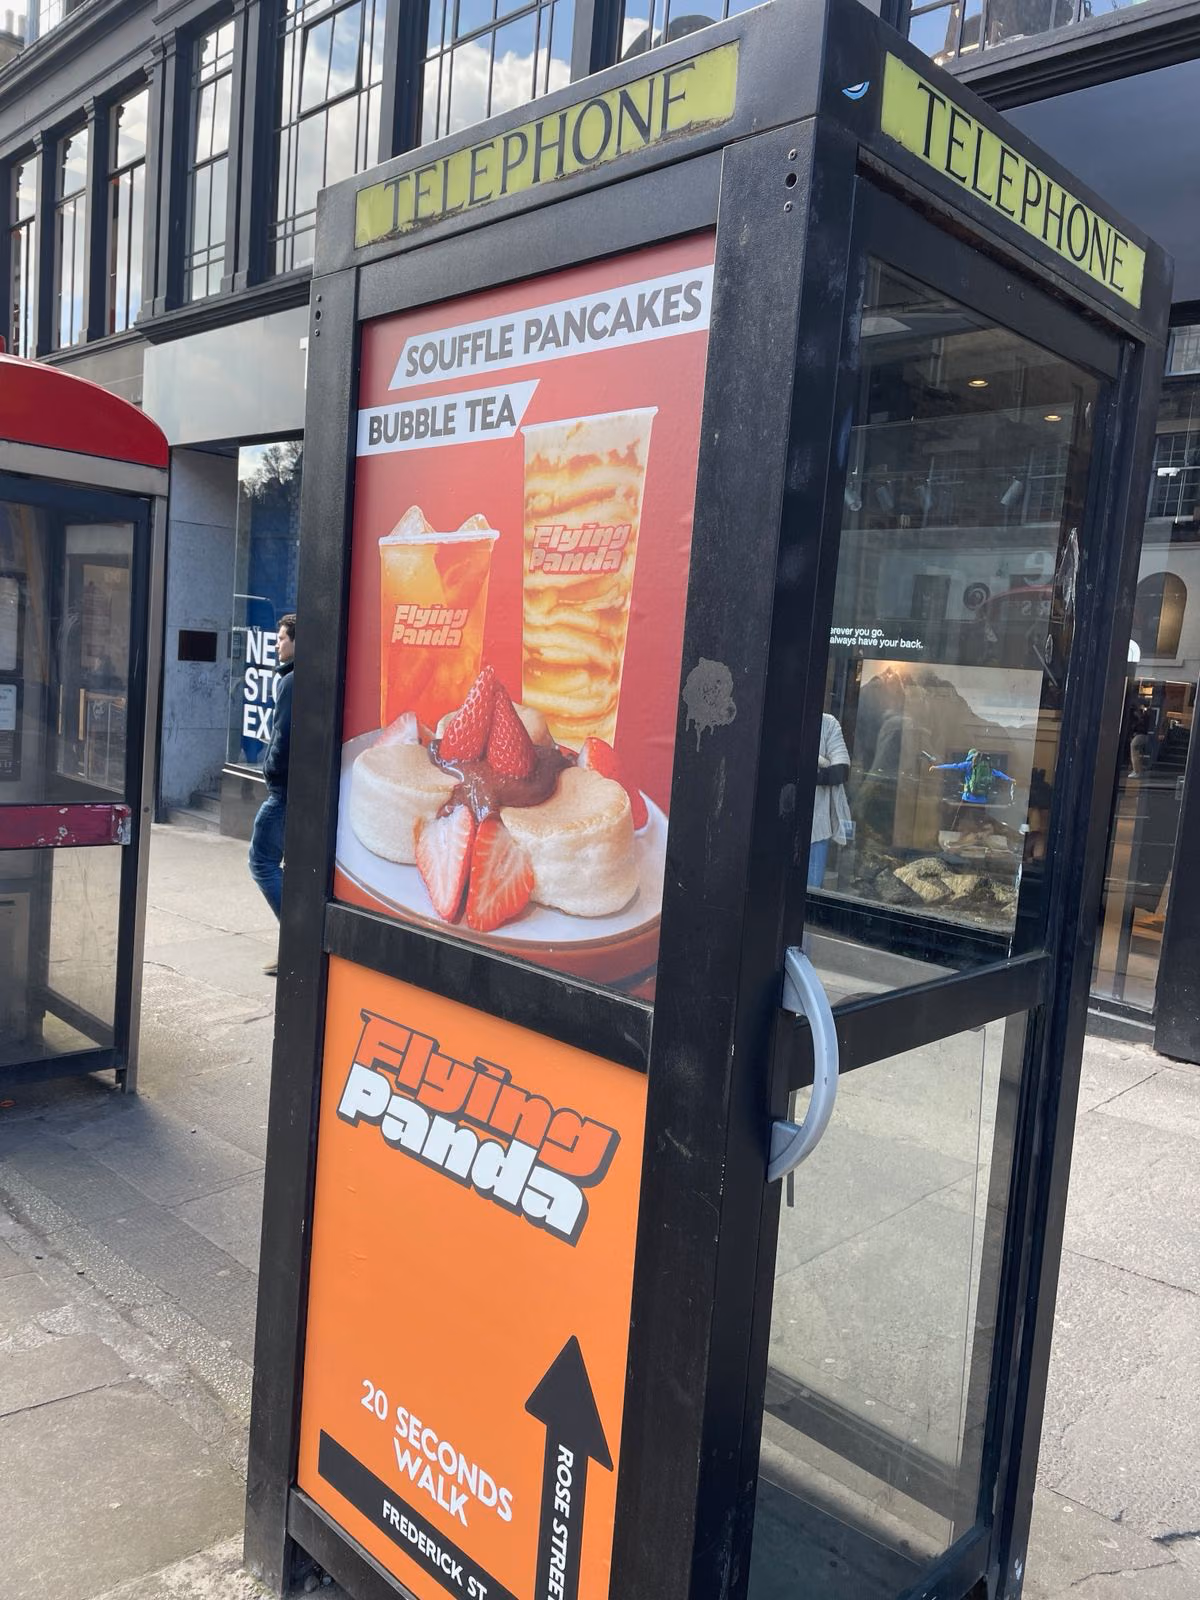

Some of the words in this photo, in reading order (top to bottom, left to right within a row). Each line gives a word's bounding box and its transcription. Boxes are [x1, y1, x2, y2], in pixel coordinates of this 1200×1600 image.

[384, 62, 696, 229] TELEPHONE
[917, 81, 1129, 293] TELEPHONE
[405, 323, 515, 378] SOUFFLE
[523, 280, 703, 355] PANCAKES
[368, 402, 456, 446] BUBBLE
[465, 393, 517, 433] TEA
[529, 547, 625, 574] Panda
[532, 523, 632, 552] Flying
[246, 630, 280, 666] NE
[391, 624, 464, 647] Panda
[393, 604, 468, 628] Flying
[829, 635, 857, 646] always
[858, 636, 878, 646] have
[879, 639, 899, 648] your
[900, 638, 924, 649] back.
[854, 628, 870, 637] you
[871, 629, 885, 638] go.
[242, 704, 275, 741] EX
[354, 1008, 622, 1188] Flying
[336, 1062, 590, 1248] Panda
[361, 1379, 388, 1421] 20
[395, 1406, 513, 1522] SECONDS
[393, 1437, 469, 1527] WALK
[554, 1444, 574, 1519] ROSE
[382, 1499, 463, 1587] FREDERICK
[467, 1576, 488, 1600] ST
[547, 1518, 568, 1600] STREE
